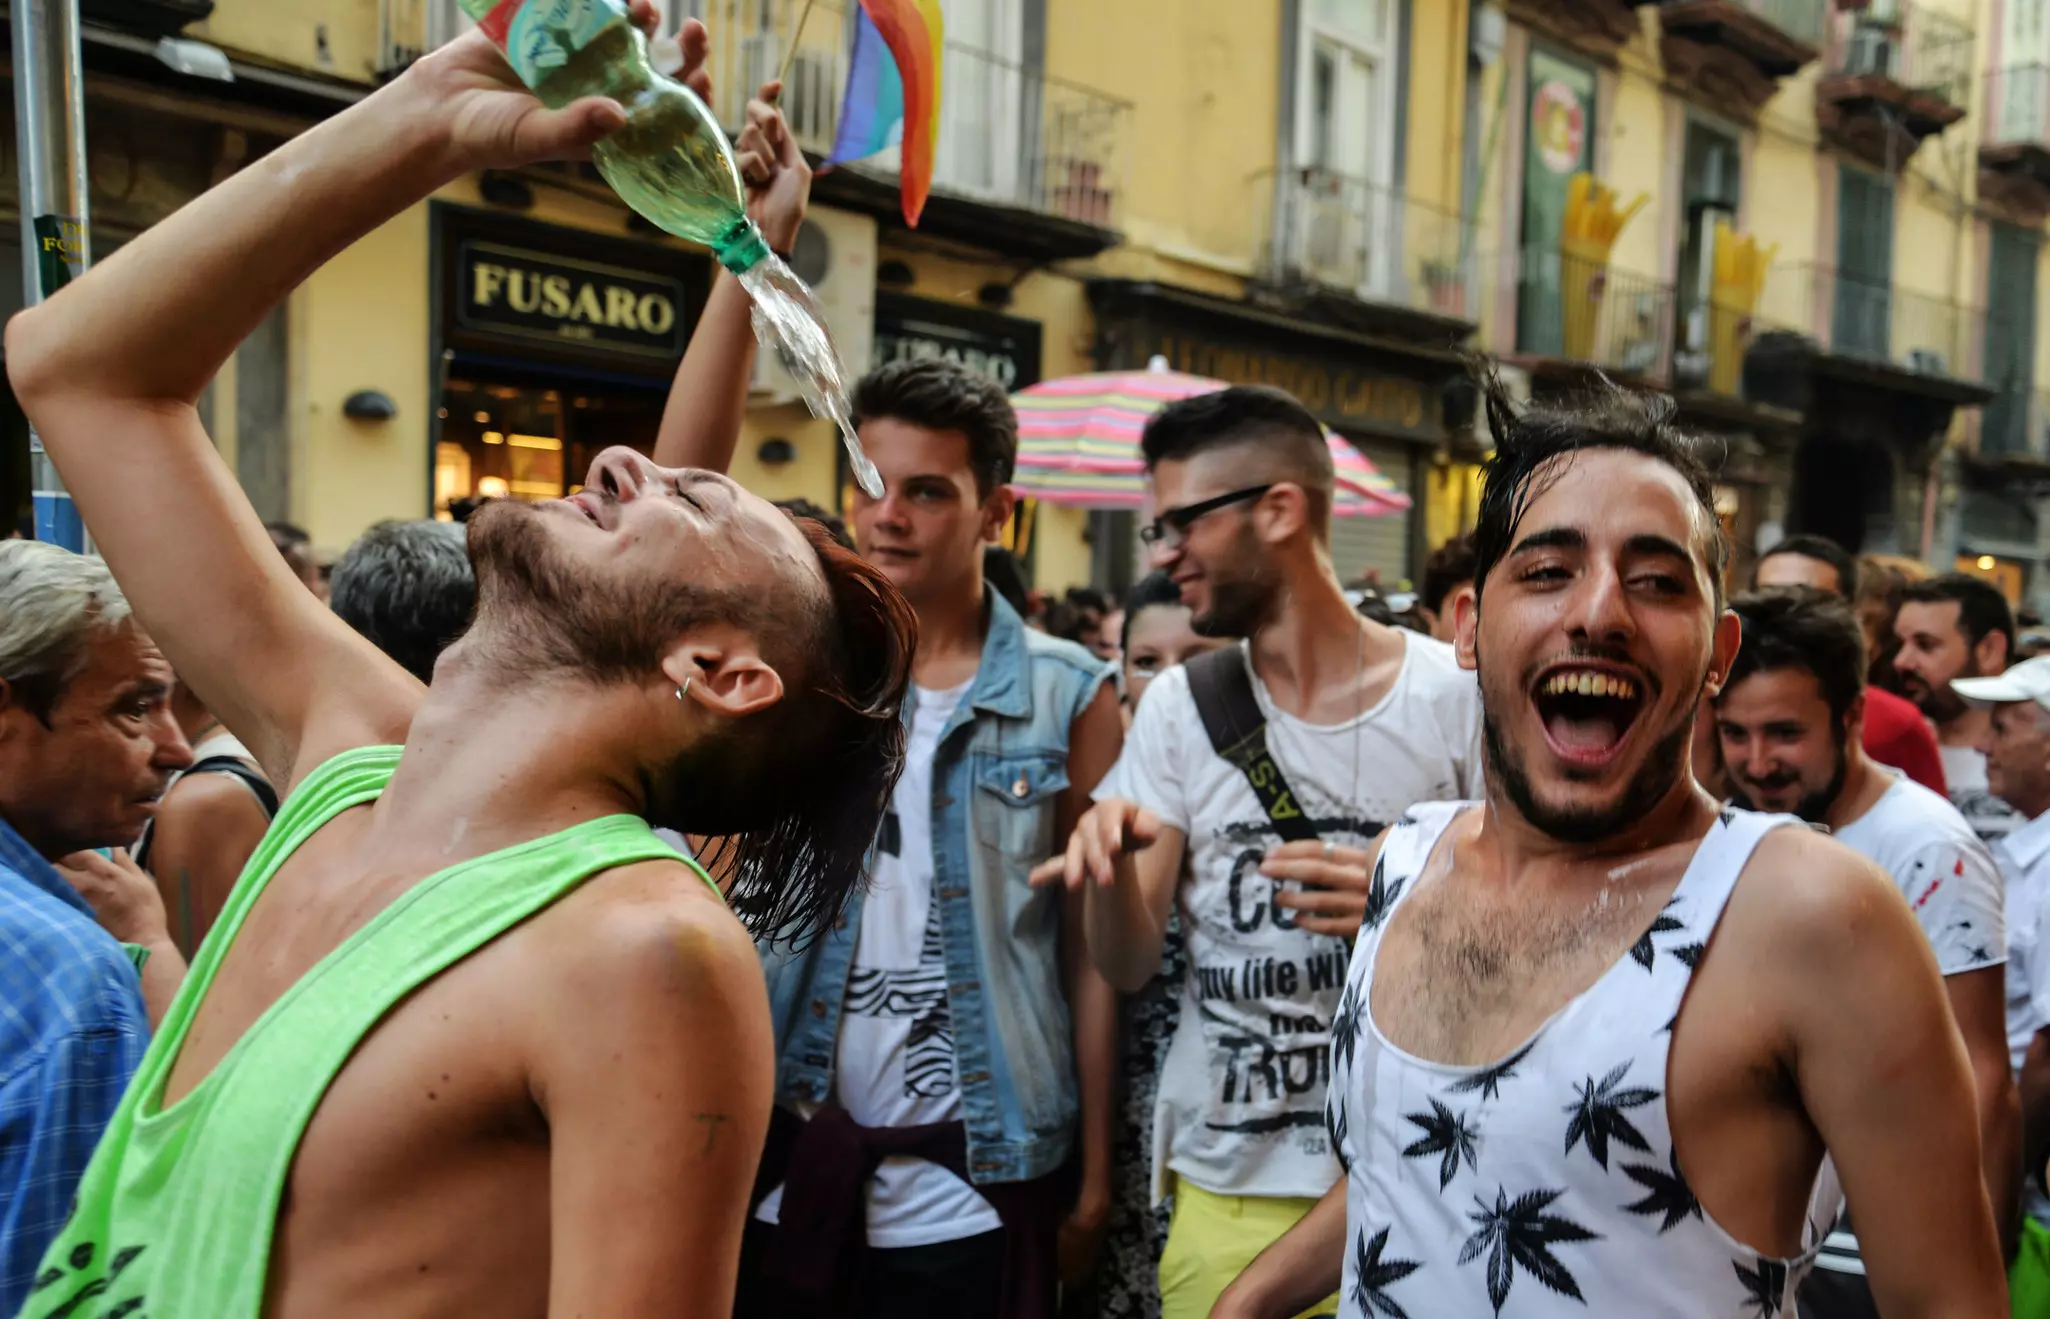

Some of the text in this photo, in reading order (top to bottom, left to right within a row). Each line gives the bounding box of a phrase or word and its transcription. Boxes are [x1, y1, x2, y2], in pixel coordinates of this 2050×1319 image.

[473, 262, 675, 335] FUSARO
[1199, 943, 1349, 1003] my life wi
